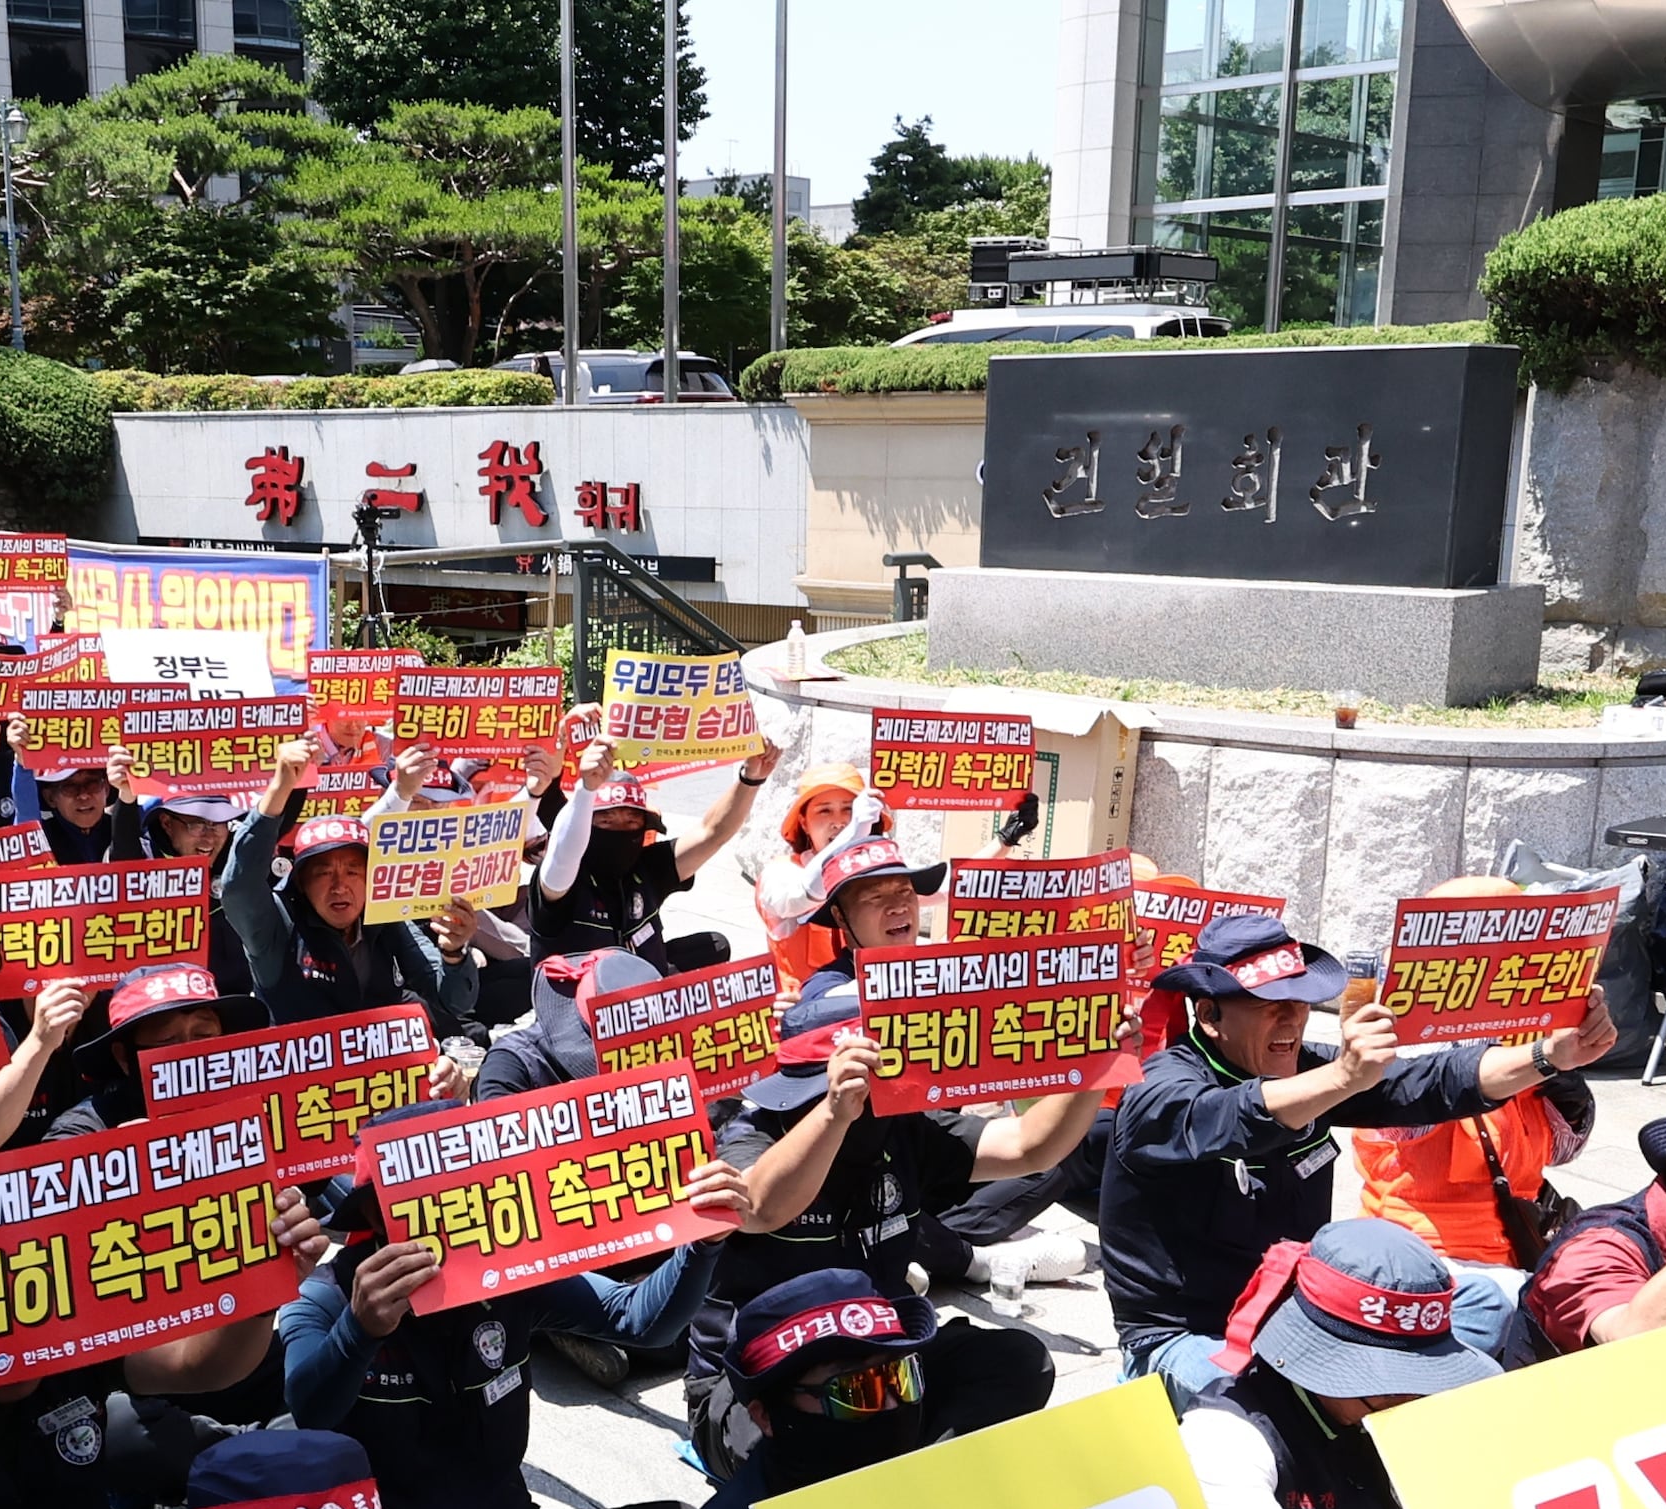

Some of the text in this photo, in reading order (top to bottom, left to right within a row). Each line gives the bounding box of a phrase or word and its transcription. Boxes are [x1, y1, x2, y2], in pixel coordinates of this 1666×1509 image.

[1043, 422, 1382, 524] 건설회관
[35, 538, 66, 554] 단체교섭
[14, 558, 67, 580] 촉구한다
[41, 639, 79, 671] 단체교섭
[153, 656, 229, 679] 정부는
[22, 689, 127, 711] 레미콘제조사의
[399, 674, 559, 698] 레미콘제조사의 단체교섭
[613, 660, 710, 696] 우리모두
[25, 717, 93, 751] 강력히
[123, 703, 304, 735] 레미콘제조사의 단체교섭
[396, 704, 468, 741] 강력히
[474, 703, 559, 739] 촉구한다
[608, 703, 690, 739] 임단협
[875, 718, 1032, 747] 레미콘제조사의 단체교섭
[125, 739, 202, 779] 강력히
[872, 751, 1032, 791] 강력히 촉구한다
[376, 818, 459, 854] 우리모두
[462, 808, 524, 848] 단결하여
[125, 867, 203, 901] 단체교섭
[372, 850, 518, 901] 임단협 승리하자
[955, 857, 1132, 901] 레미콘제조사의 단체교섭
[83, 906, 204, 961] 촉구한다
[1398, 901, 1614, 948] 레미콘제조사의 단체교섭
[863, 944, 1120, 1002] 레미콘제조사의 단체교섭
[1384, 944, 1605, 1016] 강력히 촉구한다
[594, 964, 777, 1041] 레미콘제조사의 단체교섭
[691, 1006, 779, 1075] 촉구한다
[869, 994, 1122, 1079] 강력히 촉구한다
[151, 1019, 430, 1100] 레미콘제조사의 단체교섭
[148, 1116, 266, 1190] 단체교섭
[376, 1074, 693, 1187] 레미콘제조사의 단체교섭
[390, 1130, 708, 1266] 강력히 촉구한다
[90, 1182, 279, 1301] 촉구한다
[504, 1232, 655, 1282] 한국노총 전국레미콘운송노동조합
[22, 1302, 216, 1367] 한국노총 전국레미콘운송노동조합
[1360, 1296, 1420, 1331] 단결
